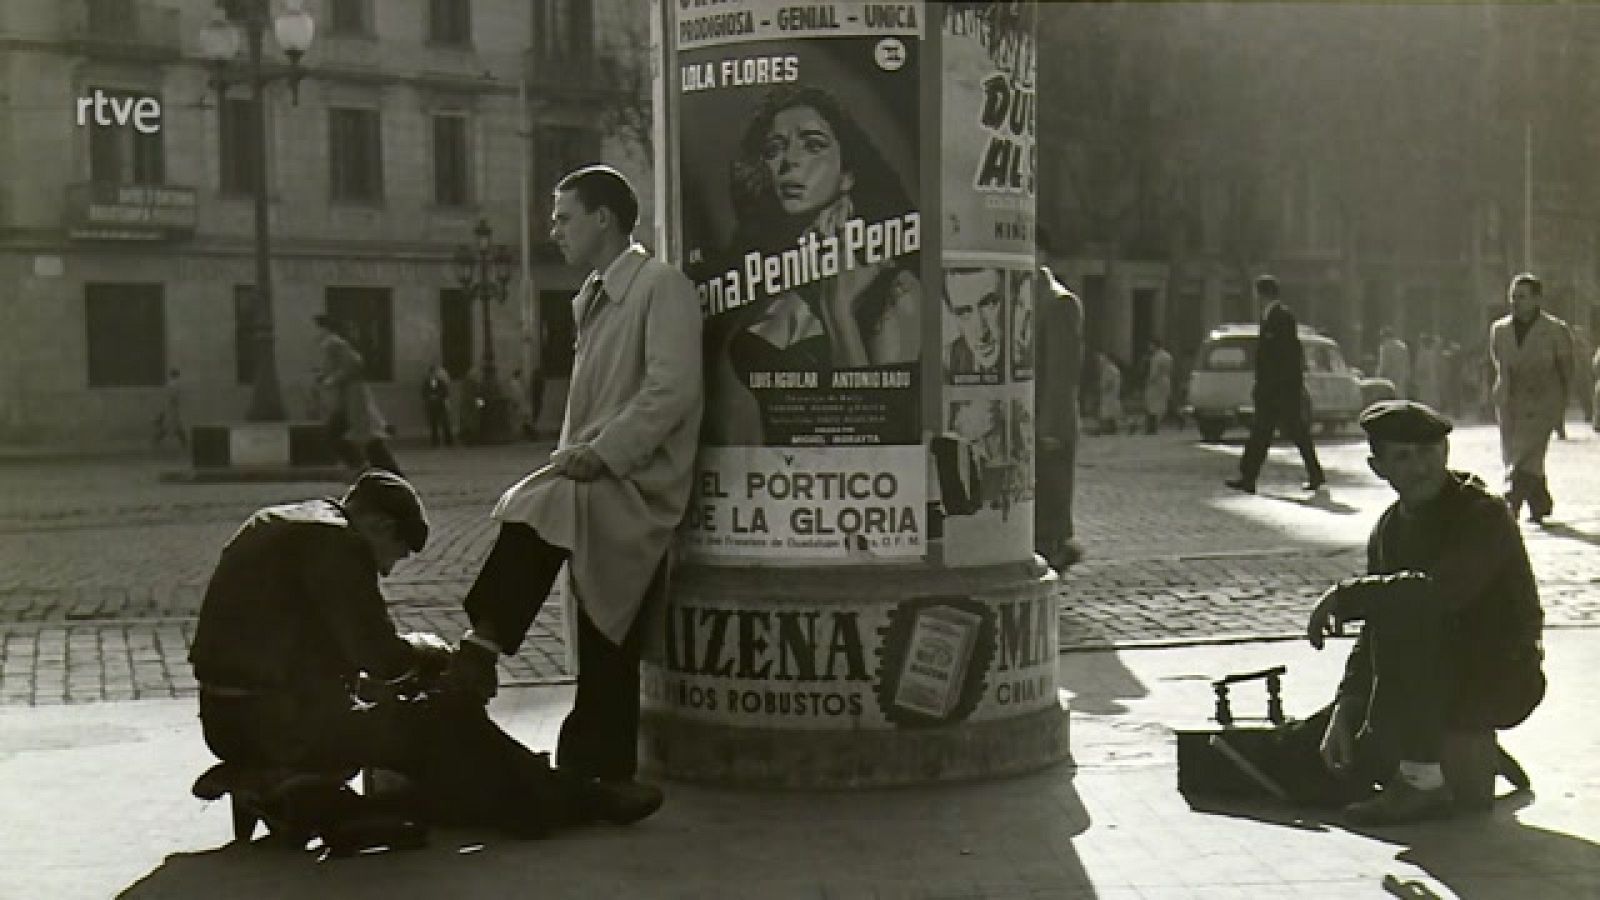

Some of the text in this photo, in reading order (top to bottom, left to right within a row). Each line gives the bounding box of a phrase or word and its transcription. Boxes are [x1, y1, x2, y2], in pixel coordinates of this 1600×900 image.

[777, 6, 841, 31] GENIAL
[681, 55, 799, 92] LOLA FLORES
[745, 230, 839, 302] Penita
[844, 211, 921, 271] Pena
[774, 371, 819, 389] AGUILAR
[832, 371, 880, 389] ANTONIO
[701, 470, 729, 498] EL
[731, 506, 769, 533] LA
[789, 506, 919, 535] GLORIA
[726, 688, 864, 718] ROBUSTOS
